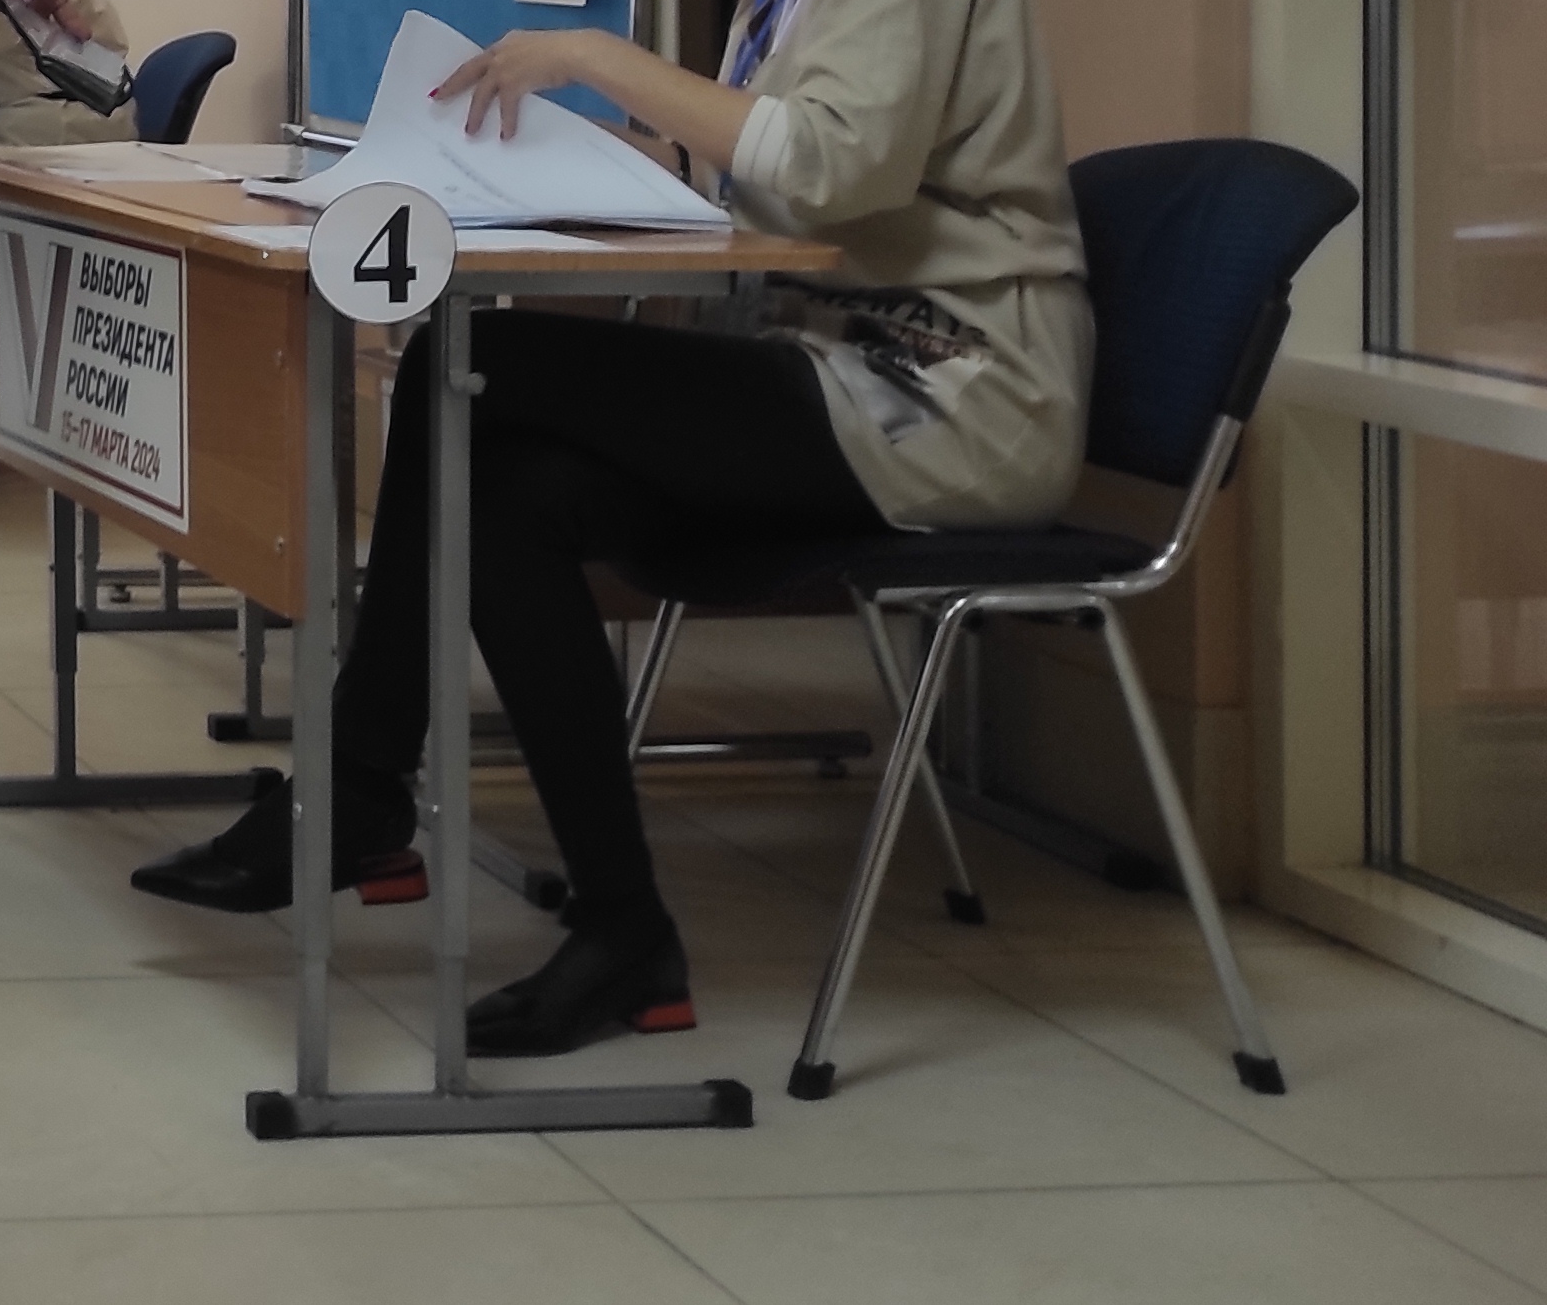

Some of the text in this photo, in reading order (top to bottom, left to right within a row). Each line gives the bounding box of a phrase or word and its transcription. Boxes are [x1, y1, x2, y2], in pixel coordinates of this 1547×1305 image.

[80, 251, 152, 308] ВЫБОРЫ
[354, 204, 417, 304] 4
[72, 305, 176, 376] ПРЕЗИДЕНТА
[66, 358, 130, 418] РОССИИ
[90, 422, 130, 469] МАРТА
[130, 438, 161, 483] 2024
